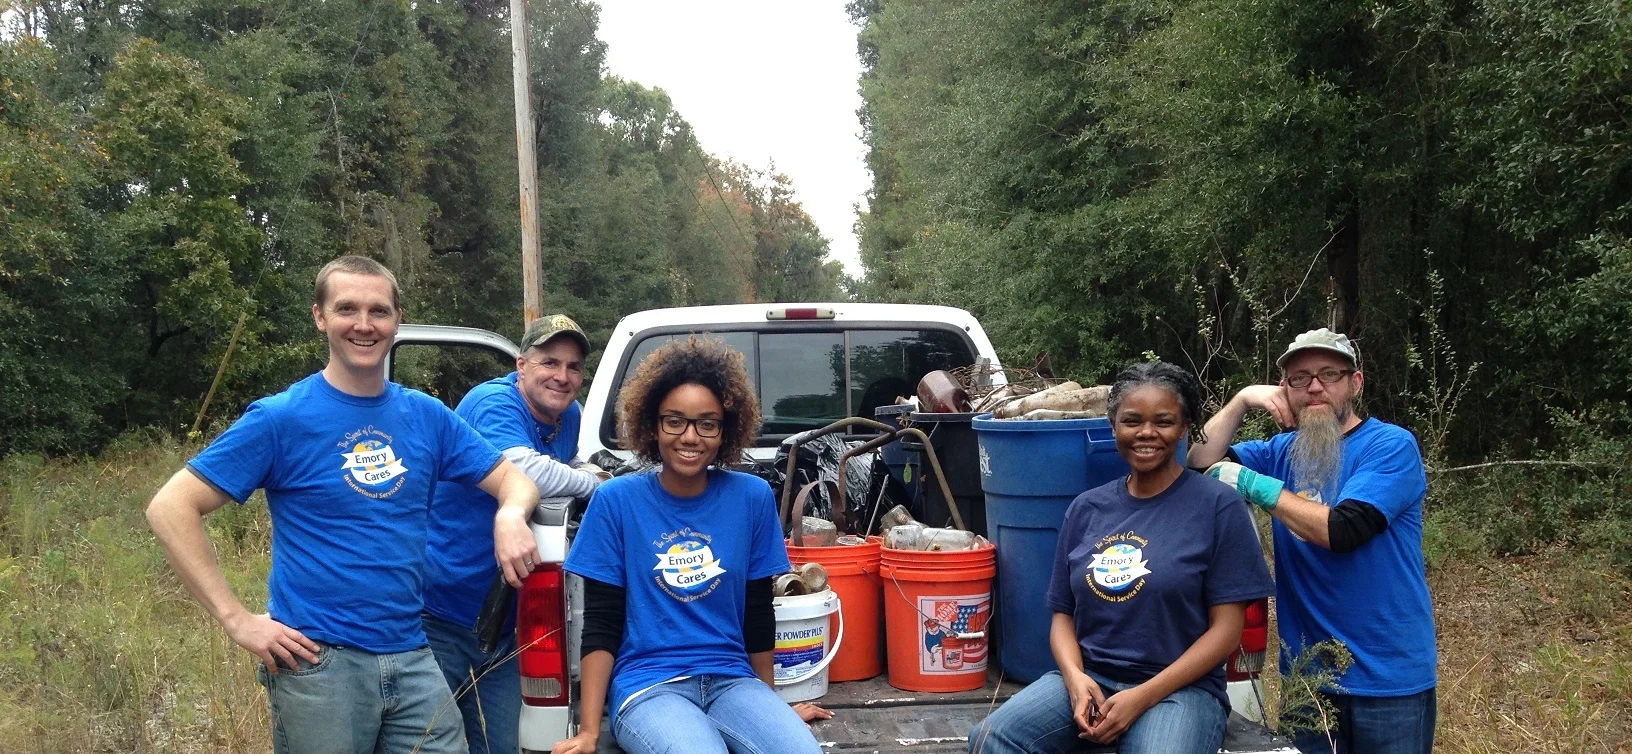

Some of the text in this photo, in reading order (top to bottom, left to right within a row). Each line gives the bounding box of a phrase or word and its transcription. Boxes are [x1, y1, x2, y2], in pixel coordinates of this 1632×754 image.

[354, 452, 387, 464] Emory
[364, 469, 391, 482] Cares
[343, 474, 406, 498] International Service Day
[668, 553, 704, 565] Emory
[1100, 556, 1134, 565] Emory
[676, 571, 707, 584] Cares
[1104, 573, 1132, 584] Cares
[654, 575, 722, 603] International Service Day
[1085, 573, 1146, 602] International Service Day
[936, 601, 957, 621] HOME
[937, 602, 947, 612] THE
[811, 627, 823, 637] PLUS
